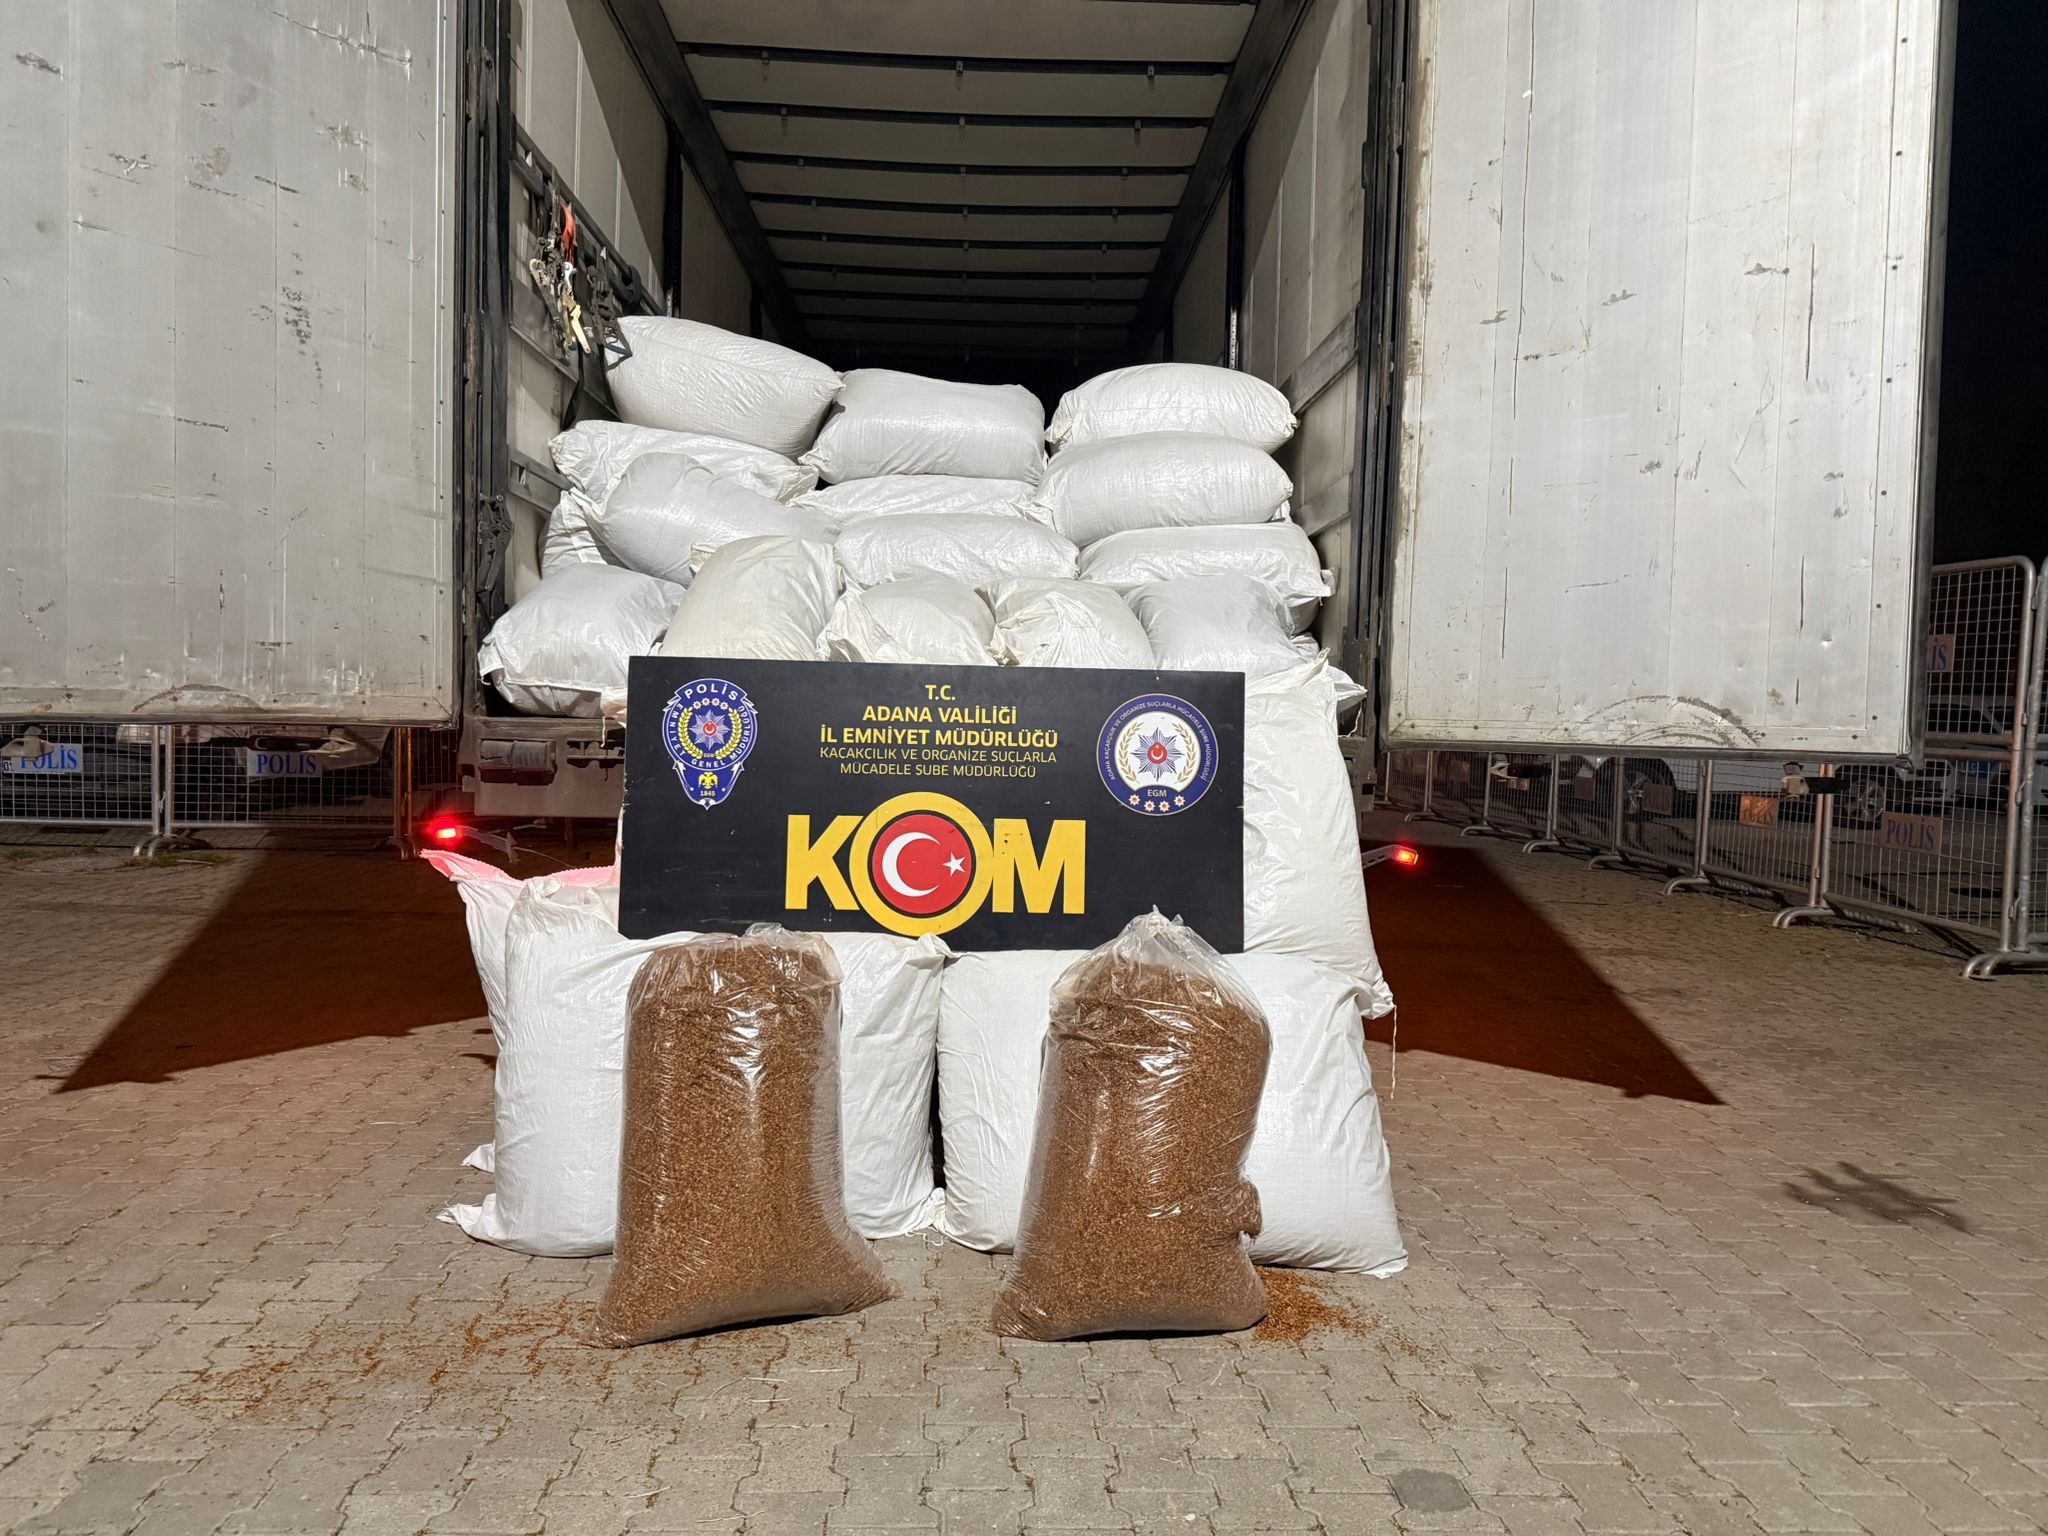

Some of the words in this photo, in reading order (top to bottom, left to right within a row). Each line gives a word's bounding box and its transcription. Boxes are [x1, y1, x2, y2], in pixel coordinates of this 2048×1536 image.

[684, 683, 738, 700] POLİS
[924, 684, 956, 701] T.C.
[863, 705, 933, 723] ADANA
[938, 705, 1017, 725] VALİLİĞİ
[820, 724, 838, 744] İL
[843, 725, 930, 746] EMNİYET
[935, 727, 1058, 748] MÜDÜRLÜĞÜ
[691, 758, 727, 768] GENEL
[900, 749, 918, 761] VE
[921, 748, 988, 762] ORGANİZE
[991, 750, 1057, 763] SUÇLARLA
[840, 762, 912, 776] MÜCADELE
[953, 764, 1036, 778] MÜDÜRLÜĞÜ
[1147, 789, 1167, 797] EGM
[1886, 817, 1935, 850] POLİS
[785, 791, 1086, 937] KOM
